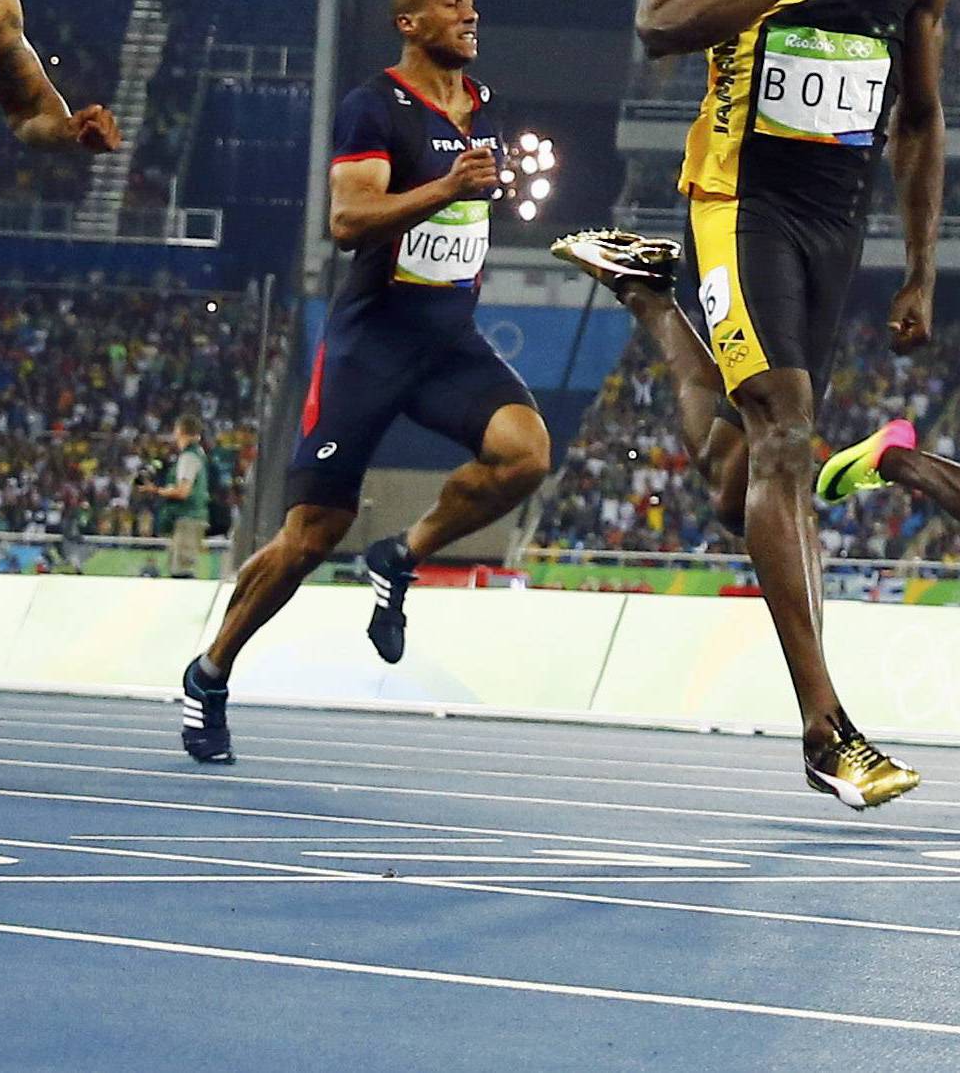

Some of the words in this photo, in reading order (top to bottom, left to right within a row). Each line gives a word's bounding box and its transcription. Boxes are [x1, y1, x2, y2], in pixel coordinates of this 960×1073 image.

[764, 67, 883, 113] BOLT
[431, 137, 499, 152] FRANCE
[407, 229, 487, 264] VICAUT
[705, 282, 717, 316] 6
